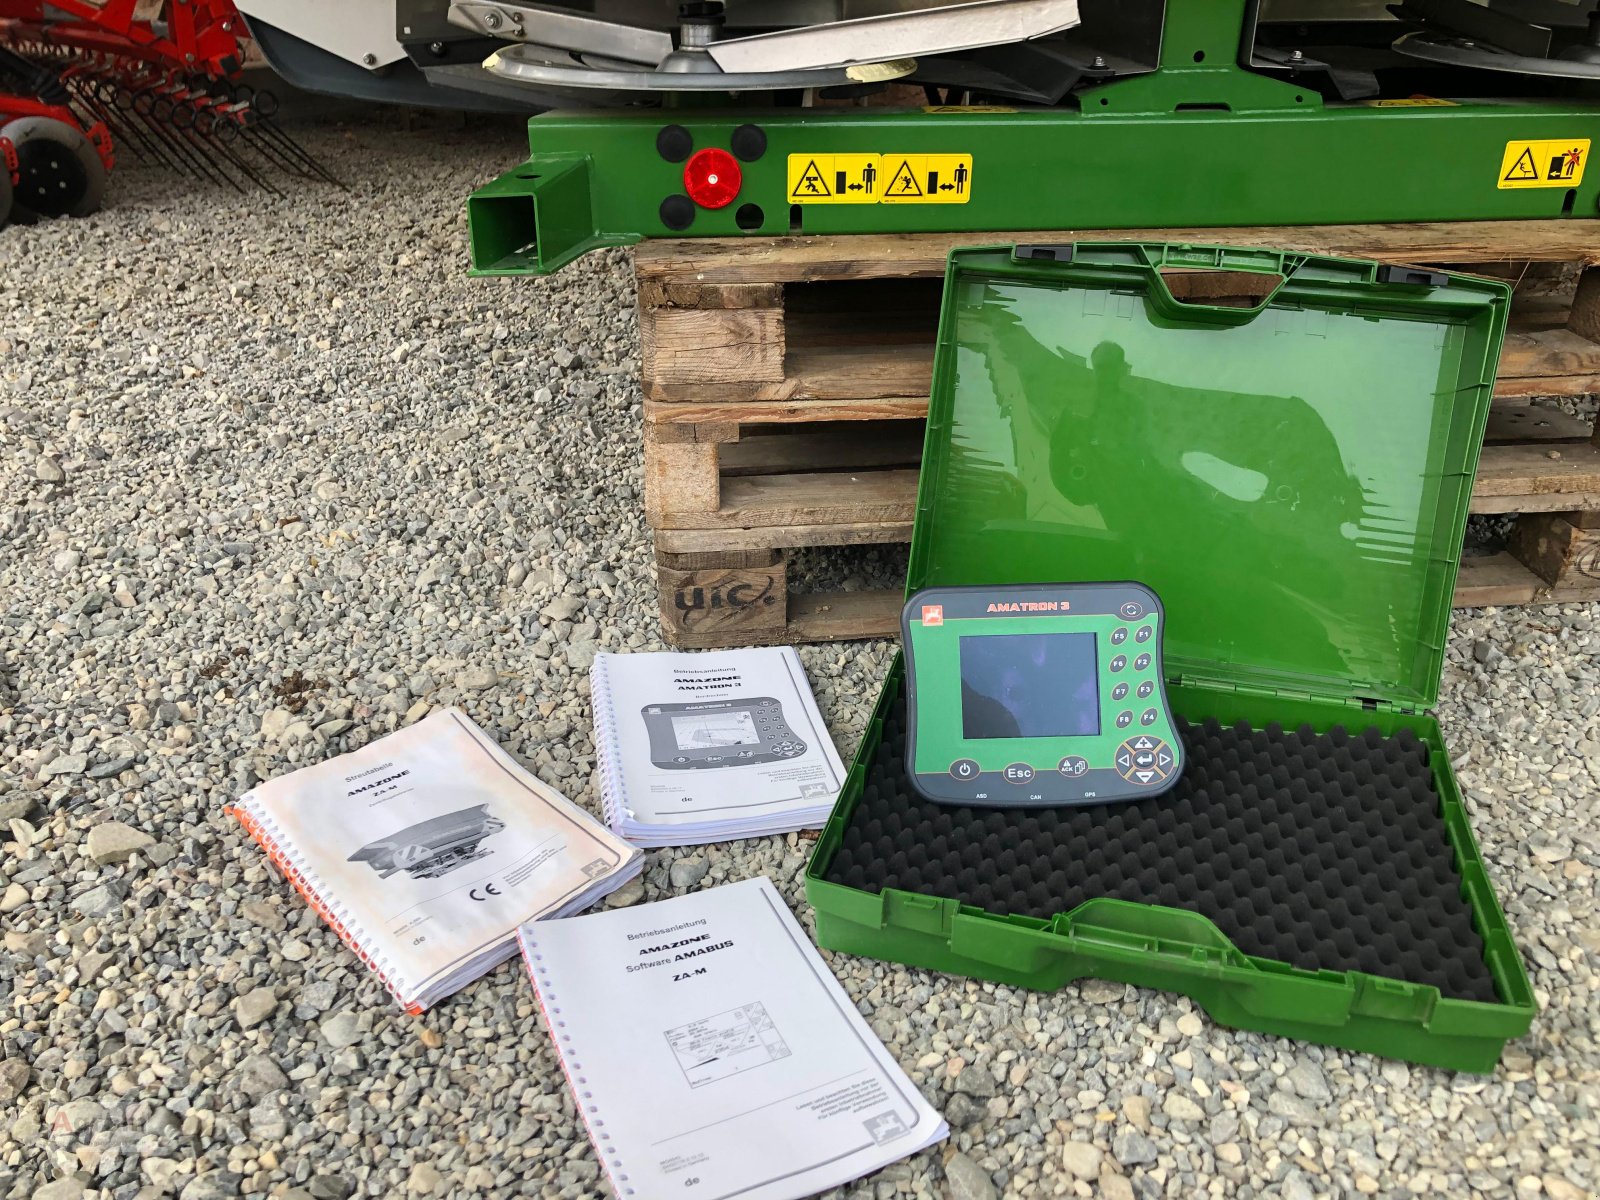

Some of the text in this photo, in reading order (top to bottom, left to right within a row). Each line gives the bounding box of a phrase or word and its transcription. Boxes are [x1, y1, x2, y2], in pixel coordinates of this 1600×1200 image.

[987, 602, 1070, 612] AMATRON 3
[345, 762, 393, 782] Streutabelle
[1008, 768, 1031, 778] Esc
[347, 770, 410, 797] AMAZONE
[373, 785, 398, 797] ZA-M
[627, 918, 707, 941] Betriebsanleitung
[413, 935, 426, 946] de
[640, 933, 711, 955] AMAZONE
[626, 940, 734, 973] Software AMABUS
[672, 967, 707, 982] ZA-M
[685, 1177, 700, 1187] de
